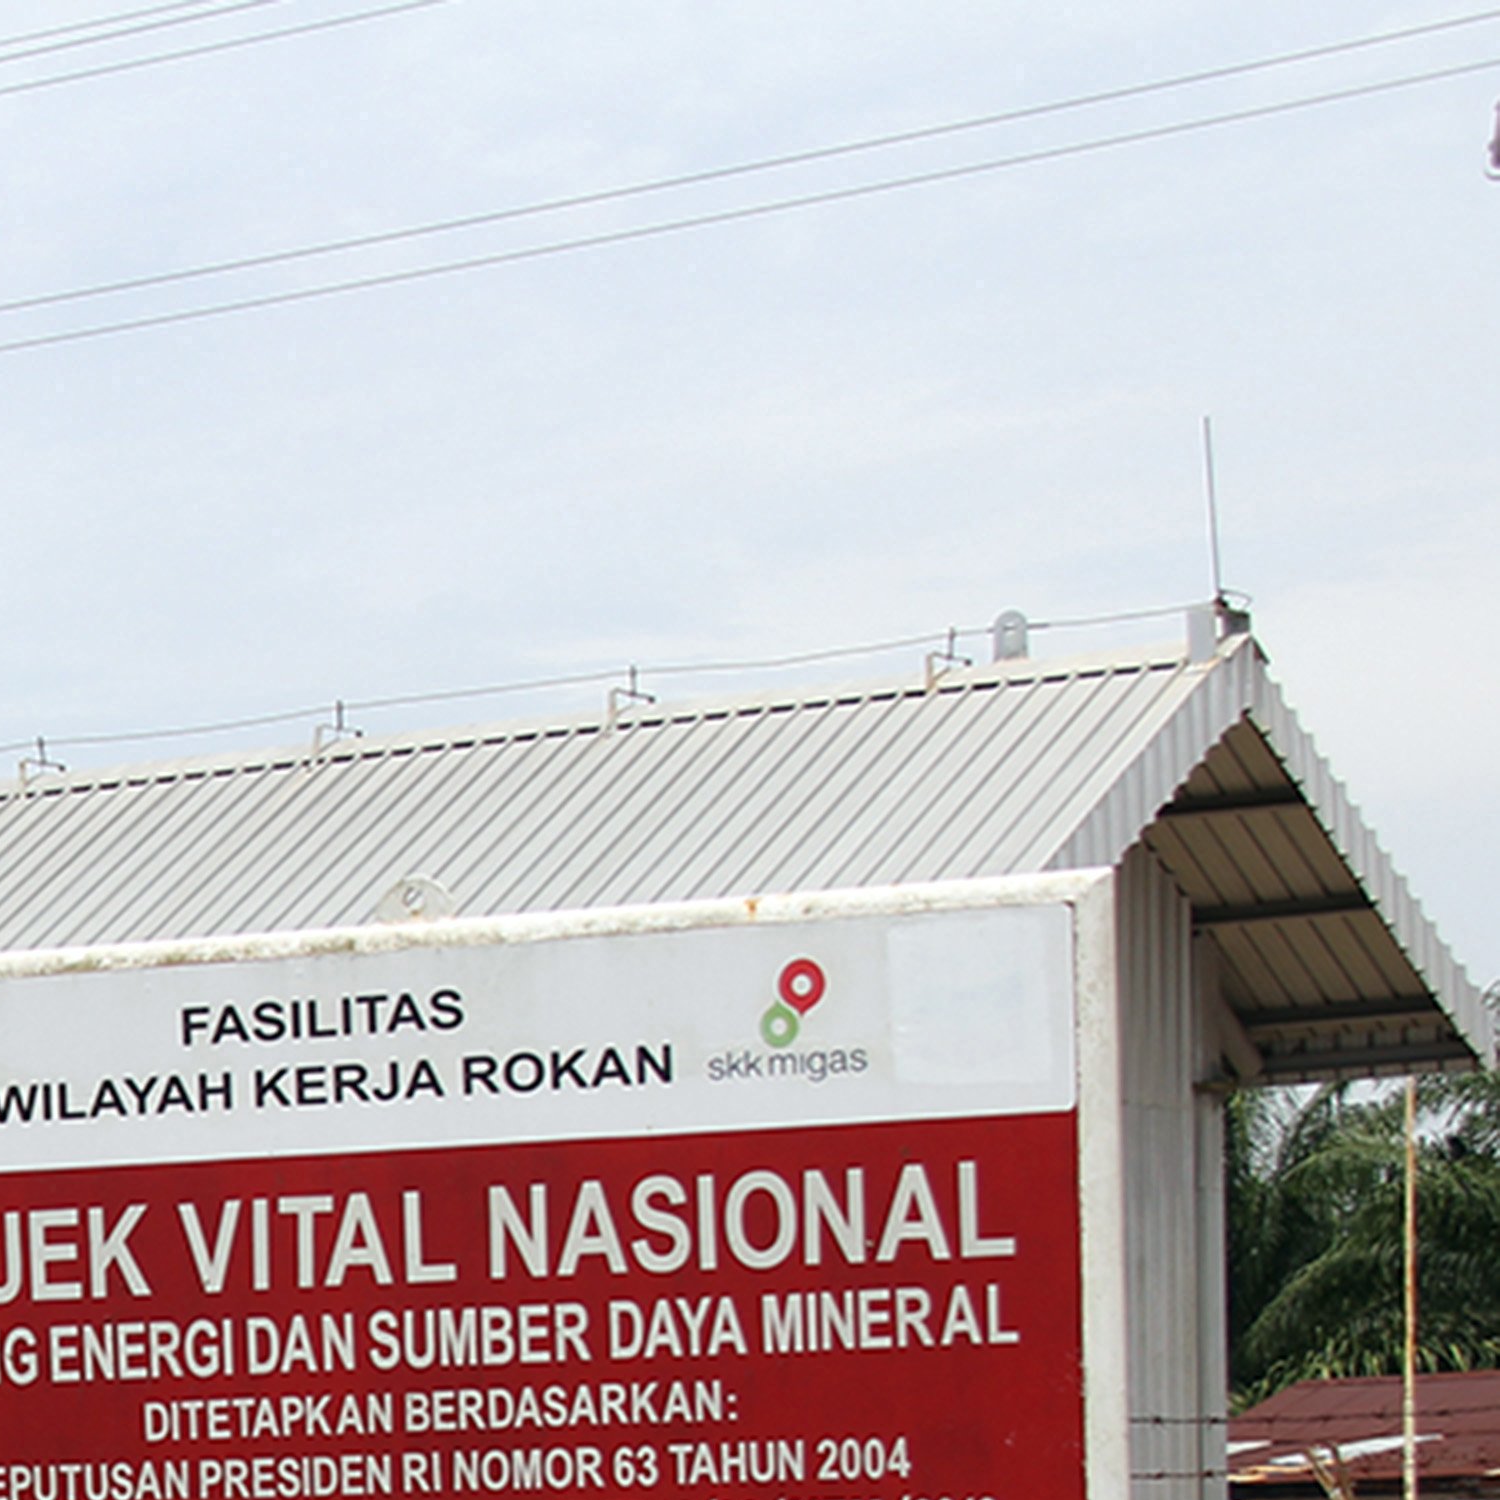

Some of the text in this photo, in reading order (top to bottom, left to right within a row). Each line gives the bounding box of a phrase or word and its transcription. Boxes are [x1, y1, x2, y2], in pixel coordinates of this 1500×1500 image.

[180, 988, 465, 1048] FASILITAS
[253, 1058, 446, 1109] KERJA
[461, 1043, 674, 1097] ROKAN
[706, 1047, 870, 1084] skk migas
[177, 1189, 458, 1295] VITAL
[487, 1159, 1017, 1280] NASIONAL
[48, 1317, 235, 1384] ENERGI
[245, 1311, 357, 1376] DAN
[368, 1301, 592, 1370] SUMBER
[608, 1295, 749, 1360] DAYA
[760, 1282, 1021, 1355] MINERAL
[143, 1378, 739, 1443] DITETAPKAN BERDASARKAN:
[198, 1453, 393, 1500] PRESIDEN
[401, 1450, 443, 1494] RI
[452, 1445, 606, 1492] NOMOR
[613, 1444, 660, 1488] 63
[667, 1438, 806, 1486] TAHUN
[815, 1436, 913, 1481] 2004
